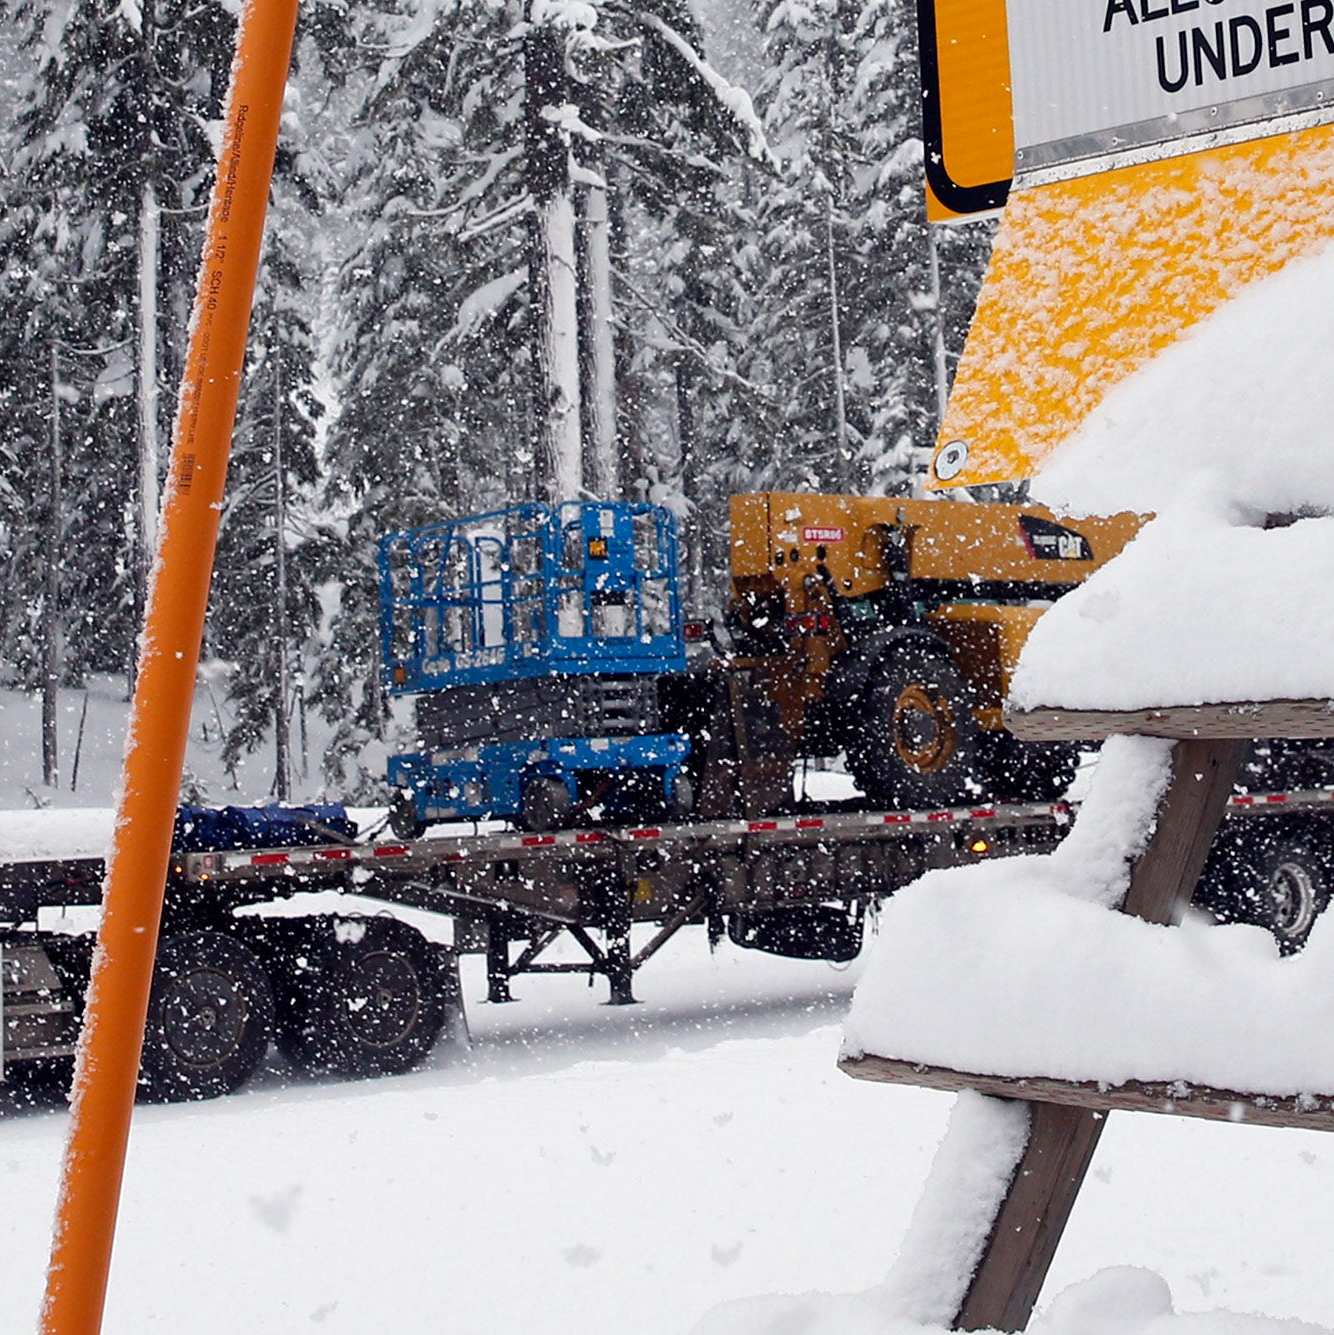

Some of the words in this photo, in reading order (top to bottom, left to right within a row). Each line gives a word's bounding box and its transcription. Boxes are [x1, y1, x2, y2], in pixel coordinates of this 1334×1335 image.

[209, 270, 223, 295] SCH
[206, 296, 217, 311] 40
[1058, 531, 1083, 559] CAT
